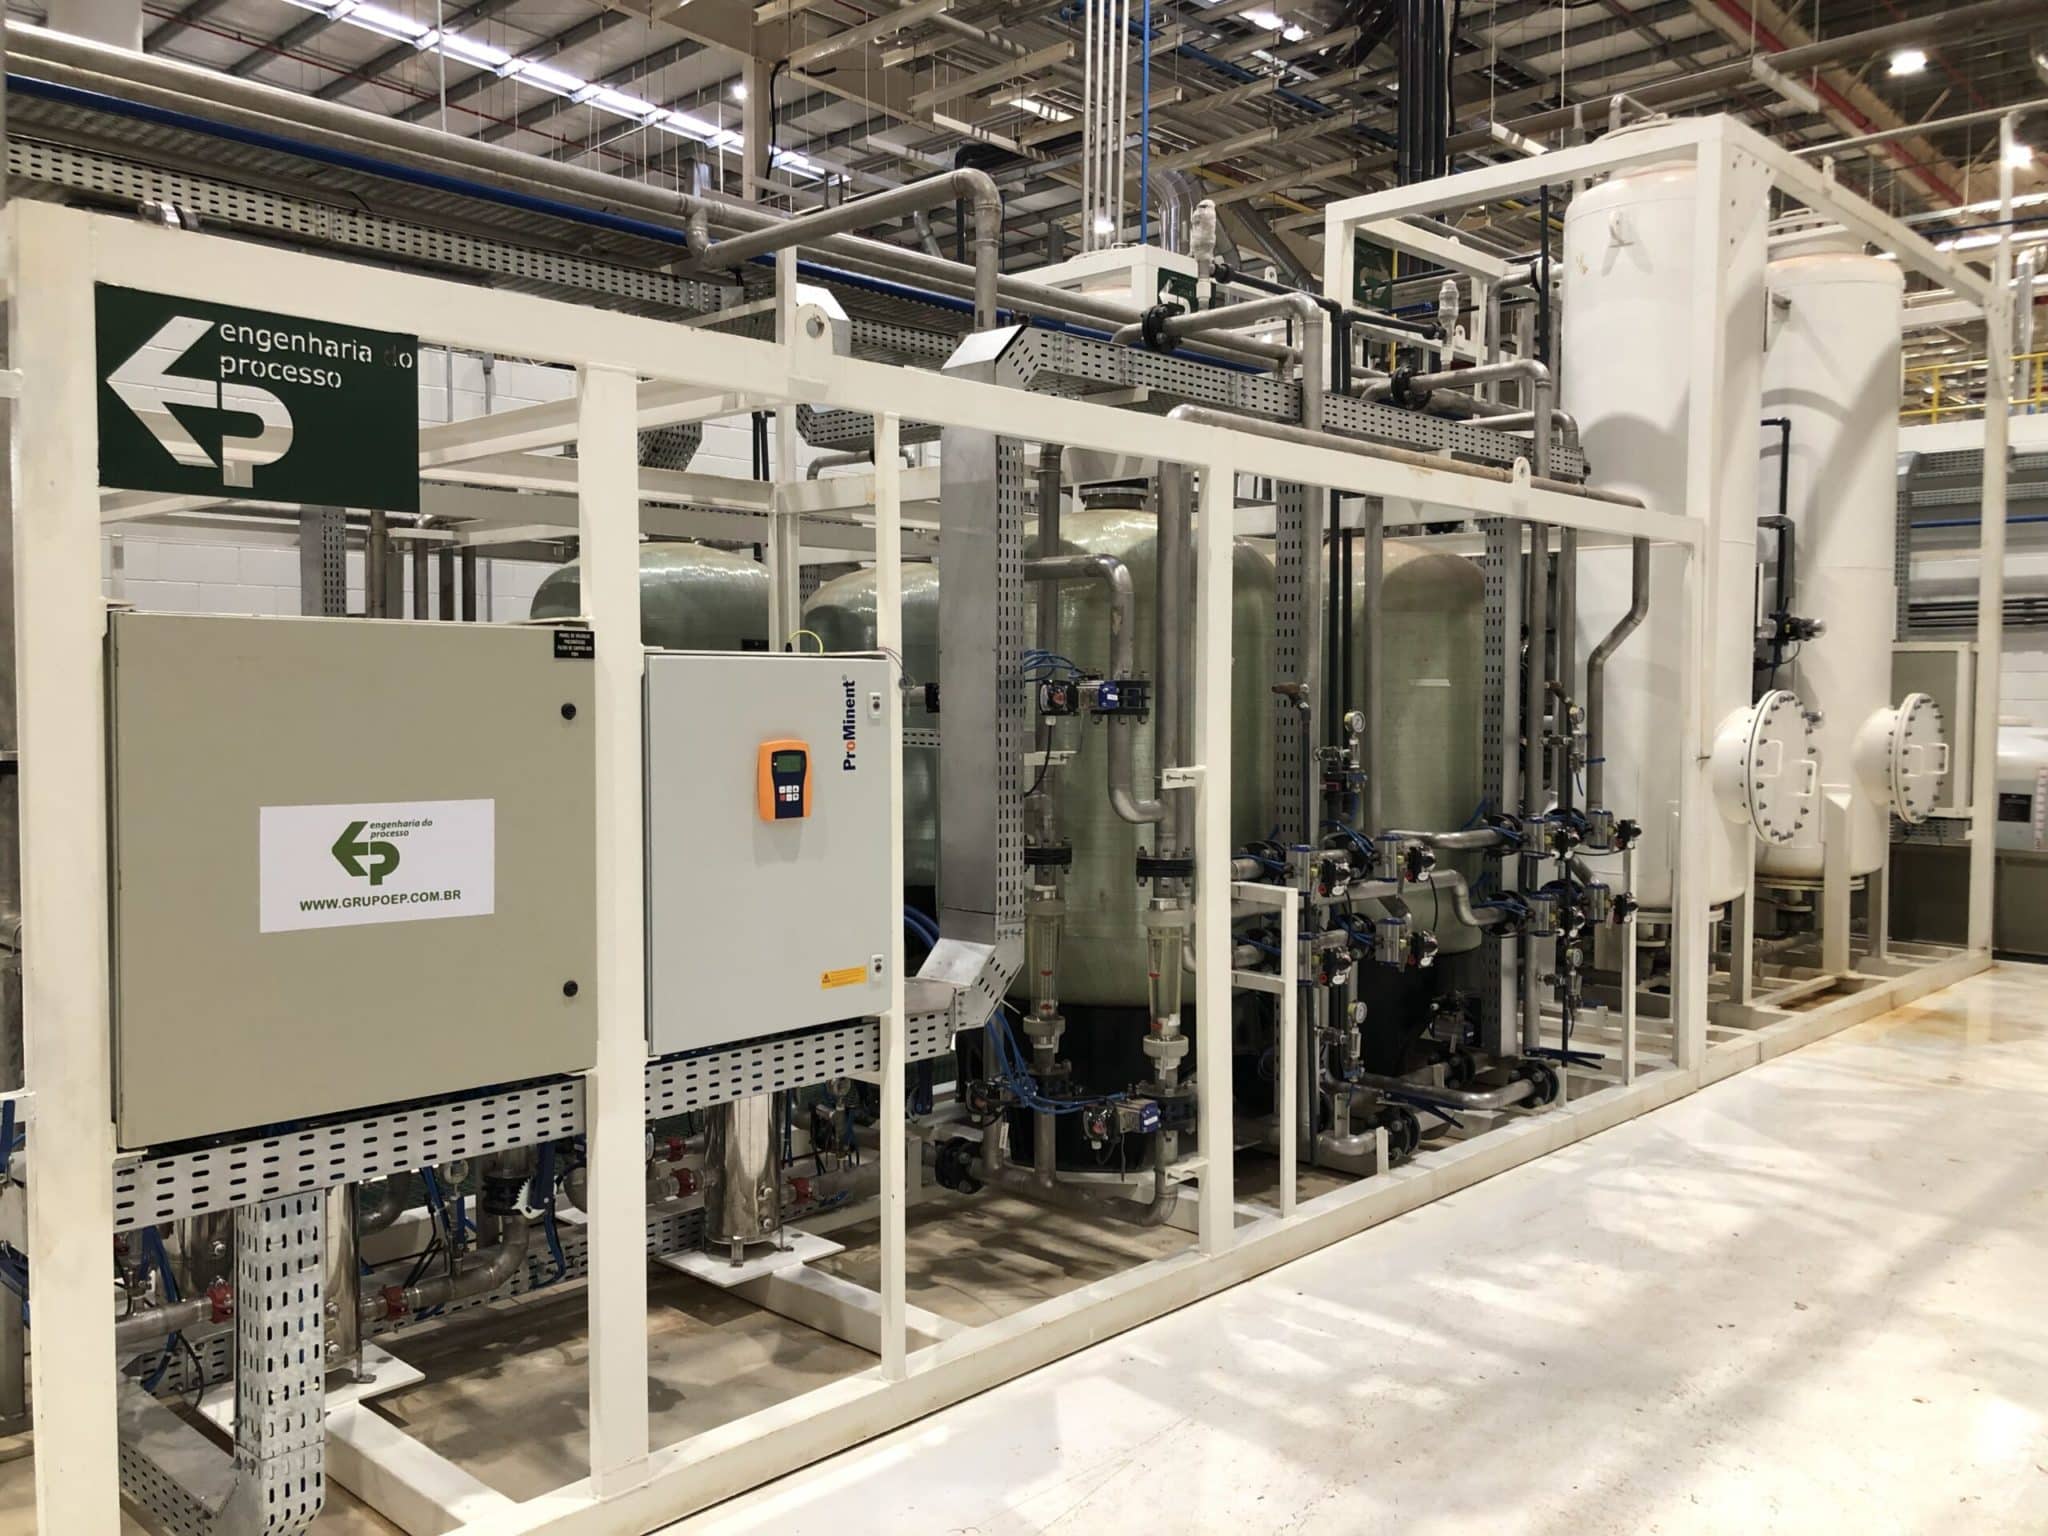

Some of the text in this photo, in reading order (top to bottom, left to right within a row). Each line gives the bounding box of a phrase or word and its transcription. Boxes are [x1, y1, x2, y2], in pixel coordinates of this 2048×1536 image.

[219, 323, 373, 364] engenharia
[219, 355, 342, 389] processo
[842, 679, 857, 771] ProMinent
[369, 818, 433, 830] engenharia do
[369, 829, 410, 840] processo
[299, 889, 462, 912] WWW.GRUPOEP.COM.BR
